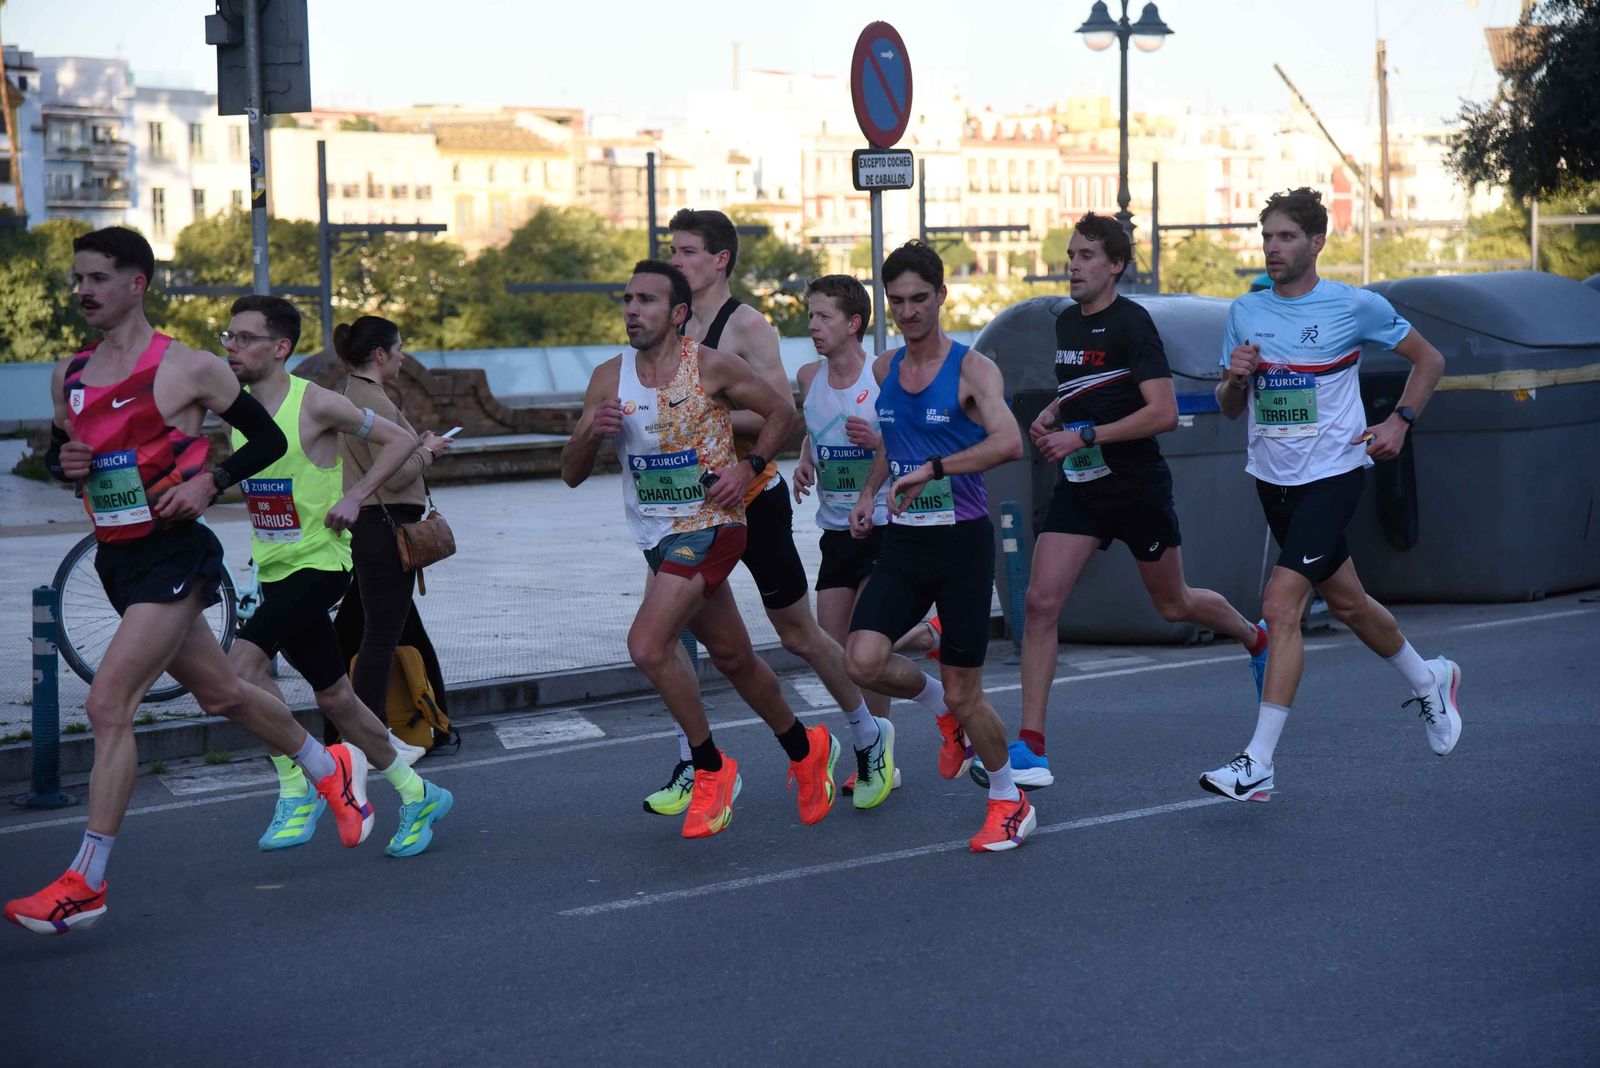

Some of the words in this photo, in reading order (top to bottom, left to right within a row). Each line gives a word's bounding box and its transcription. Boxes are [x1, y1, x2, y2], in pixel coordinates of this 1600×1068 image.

[860, 157, 886, 168] EXCEPTO
[887, 156, 911, 167] COCHES
[865, 174, 873, 185] DE
[874, 173, 906, 184] CABALLOS
[1269, 377, 1306, 387] ZURICH
[1273, 397, 1287, 405] 481
[1260, 408, 1309, 422] TERRIER
[833, 449, 865, 458] ZURICH
[92, 454, 127, 470] ZURICH
[650, 455, 689, 467] ZURICH
[837, 466, 849, 475] 581
[100, 479, 113, 490] 483
[659, 476, 673, 485] 450
[836, 478, 856, 490] JIM
[251, 483, 284, 492] ZURICH
[639, 485, 703, 502] CHARLTON
[92, 490, 137, 509] MORENO
[900, 495, 943, 509] ATHIS
